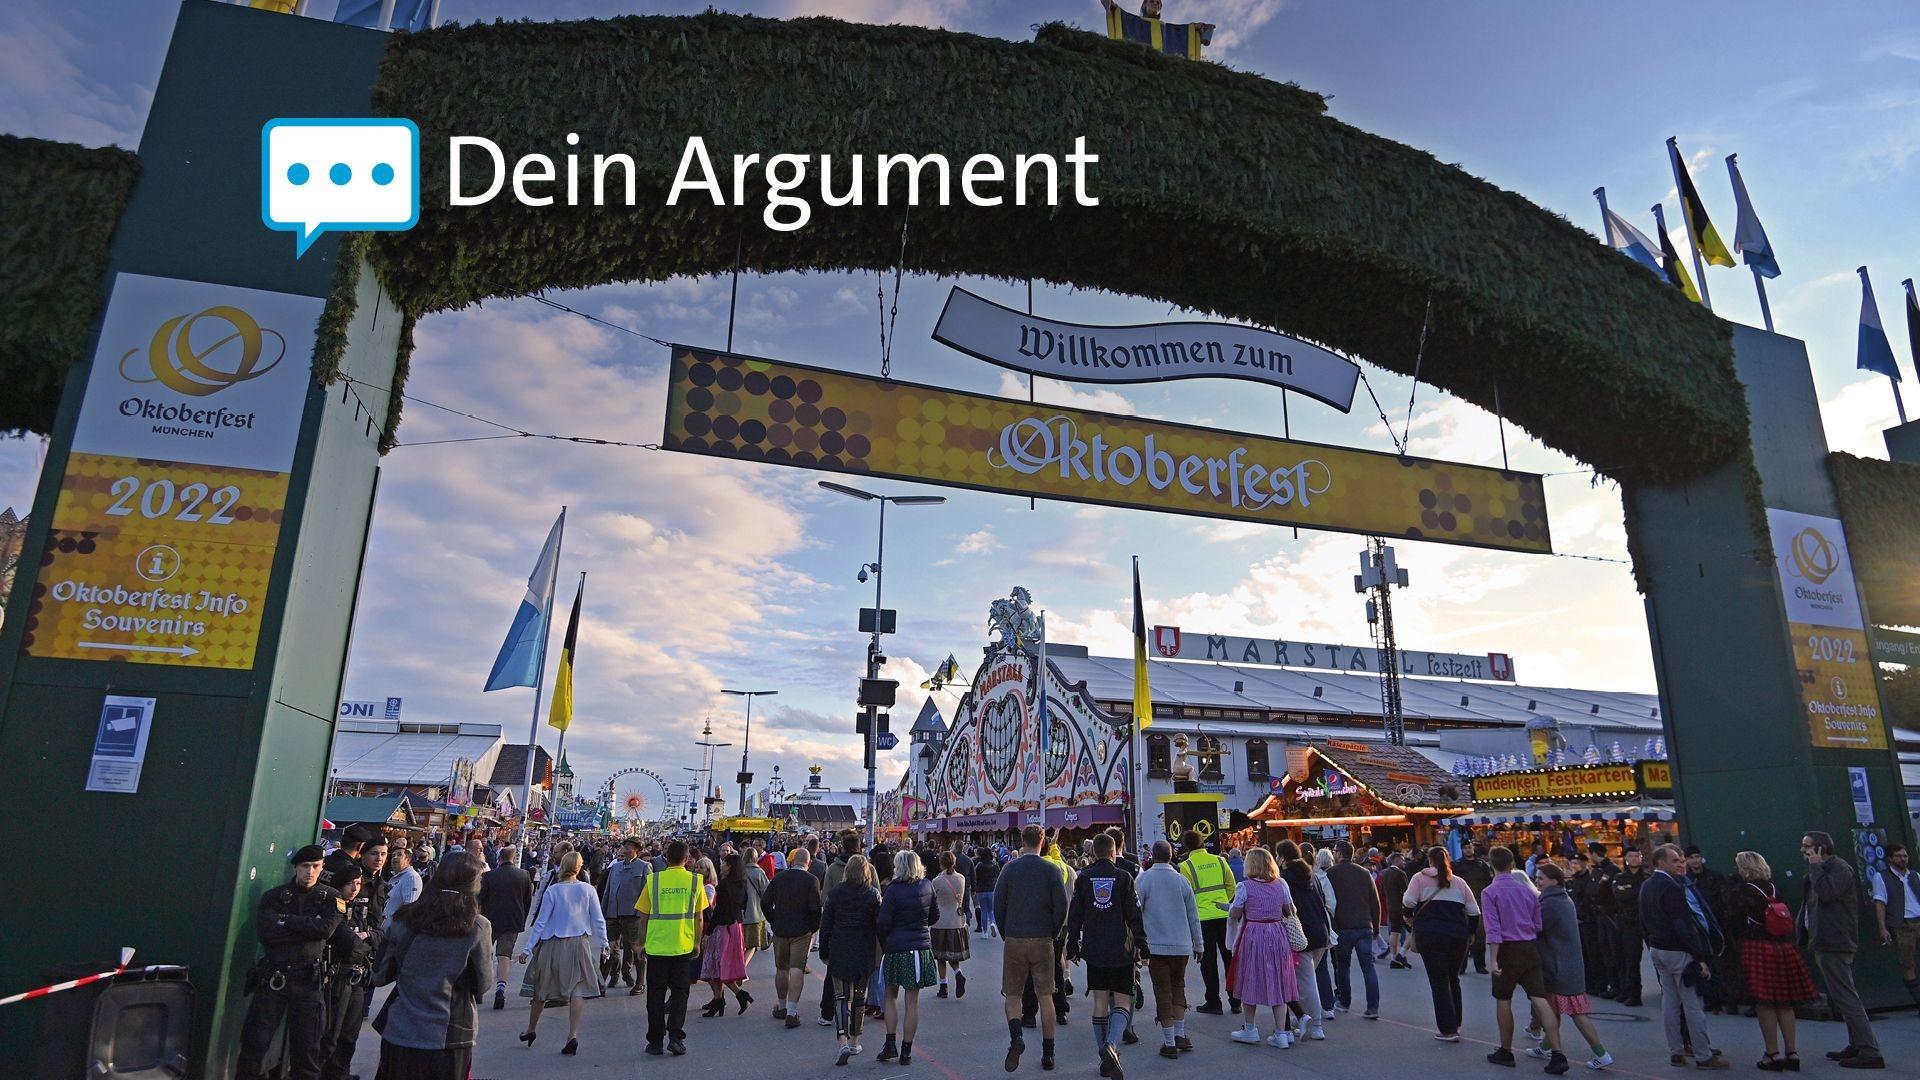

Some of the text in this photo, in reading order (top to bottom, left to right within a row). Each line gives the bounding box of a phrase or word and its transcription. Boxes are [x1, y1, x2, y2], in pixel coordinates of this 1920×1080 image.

[1018, 324, 1294, 376] Willkommen zum
[119, 397, 256, 429] Oktoberfest
[152, 425, 214, 440] MÜNCHEN
[986, 415, 1332, 511] Oktoberfest
[105, 475, 241, 525] 2022
[52, 580, 248, 615] Oktoberfest Info
[1794, 586, 1845, 604] Oktoberfest
[82, 609, 206, 637] Souvenirs
[1206, 635, 1413, 674] MARSTAL
[1808, 635, 1856, 664] 2022
[980, 663, 1023, 700] MARSTALL
[1808, 700, 1877, 719] Oktoberfest Info
[1824, 716, 1868, 731] Souvenirs
[878, 736, 892, 746] WC
[1476, 768, 1632, 792] Andenken Festkarten
[1648, 767, 1669, 782] Ma
